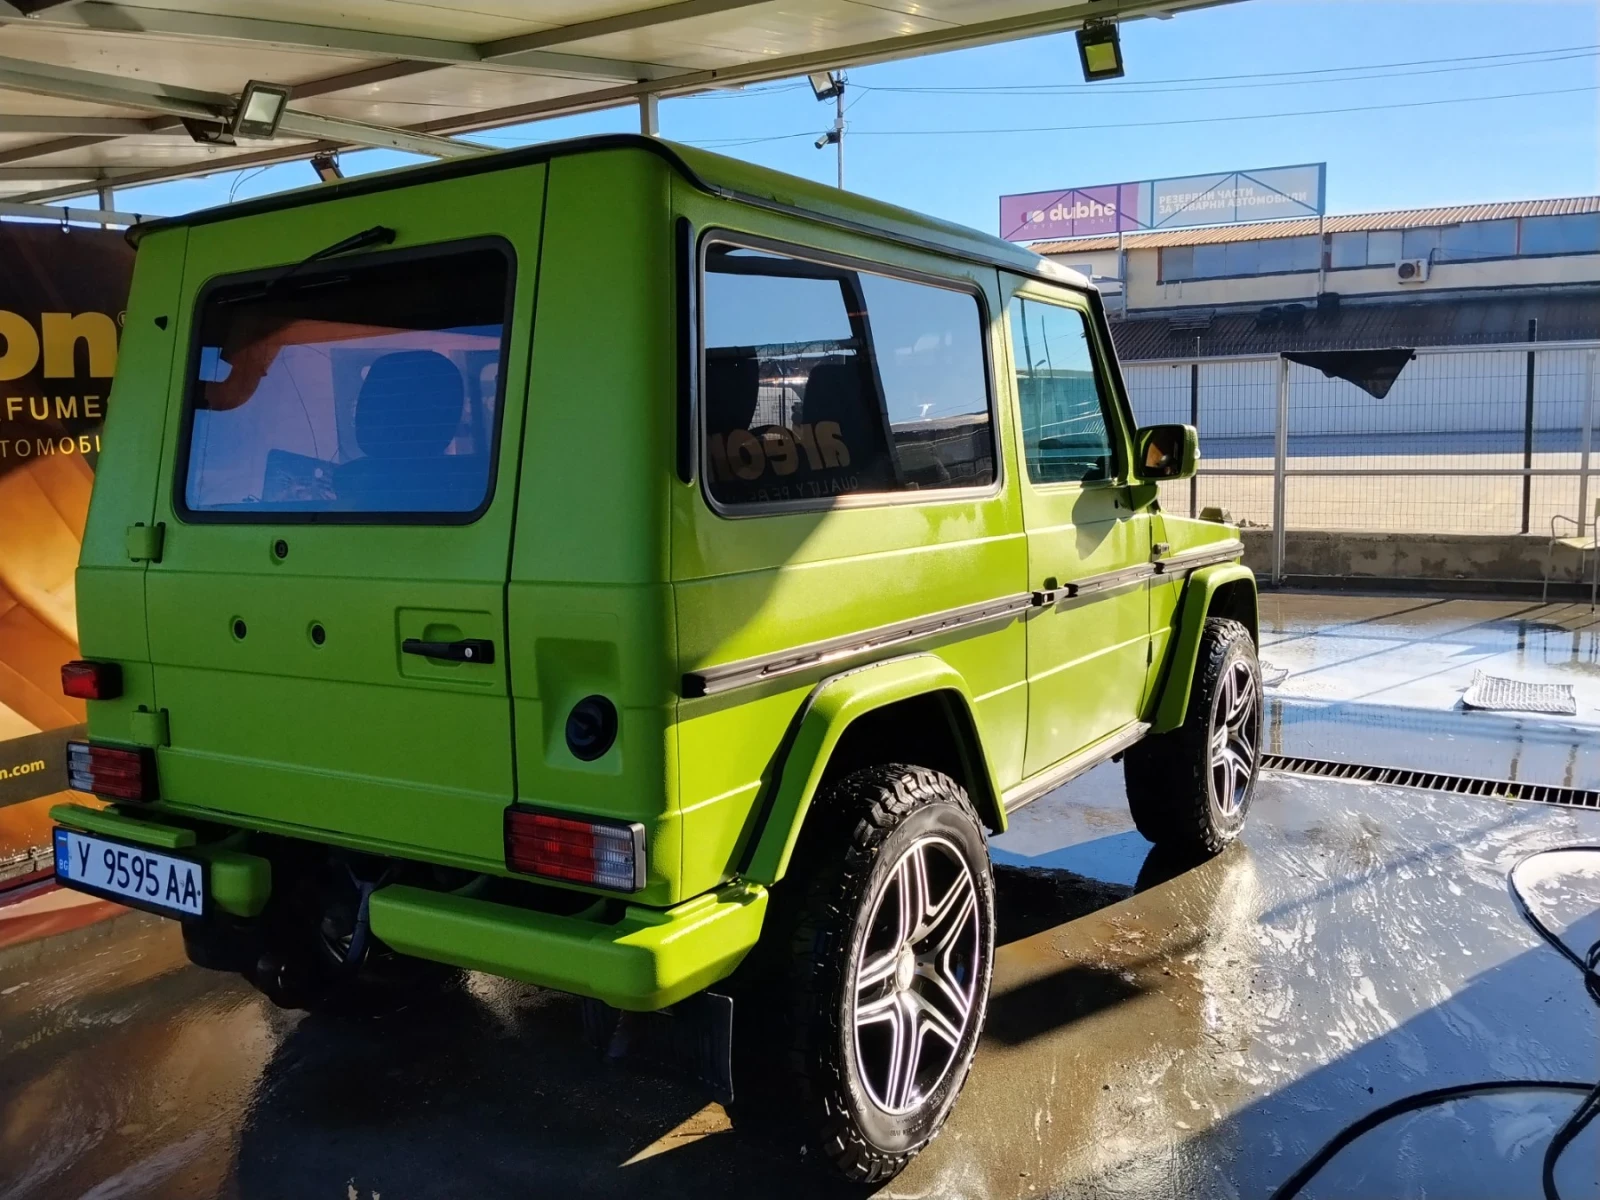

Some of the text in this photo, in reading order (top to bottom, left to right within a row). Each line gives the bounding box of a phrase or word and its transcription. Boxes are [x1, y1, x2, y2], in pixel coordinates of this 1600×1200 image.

[1217, 187, 1254, 200] ЧАСТИ
[1049, 200, 1117, 221] dubhe
[1159, 204, 1172, 214] ЗА
[1175, 201, 1225, 213] ТОВАРНИ
[59, 859, 69, 870] BG
[103, 848, 160, 897] 9595
[165, 864, 197, 908] AA
